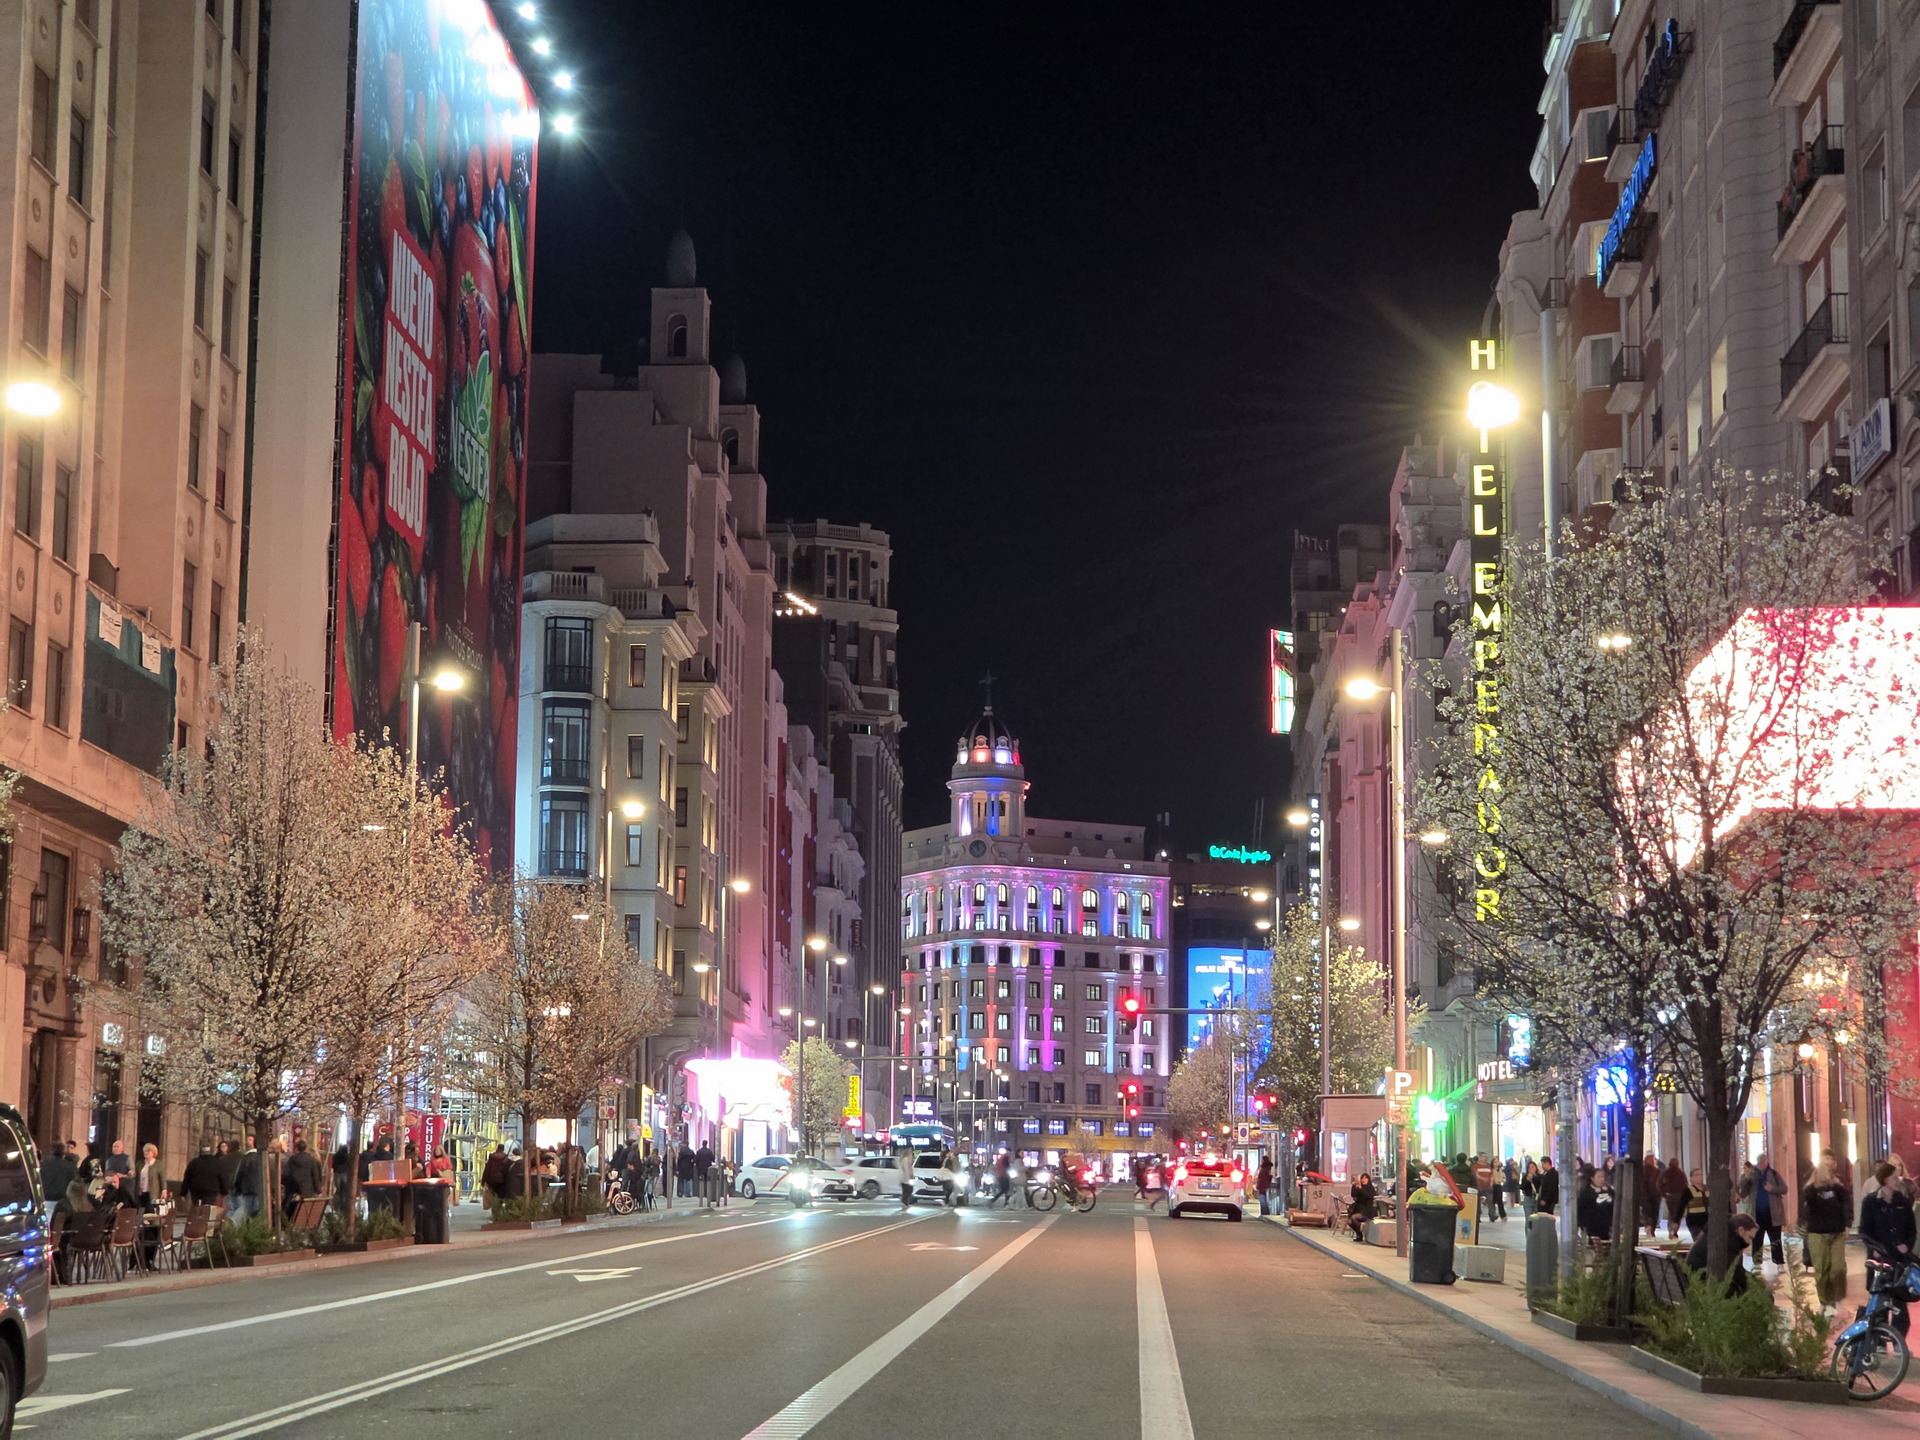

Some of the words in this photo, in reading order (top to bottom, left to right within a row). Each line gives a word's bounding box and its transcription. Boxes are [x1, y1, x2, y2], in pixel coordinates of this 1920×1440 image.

[391, 229, 435, 359] NUEVO
[385, 321, 433, 456] NESTEA
[1469, 339, 1498, 535] HTEL
[387, 422, 425, 538] ROJO
[450, 399, 490, 504] NESTEA
[1310, 798, 1320, 852] ROOM
[1395, 1071, 1412, 1095] P
[1477, 1060, 1515, 1081] HOTEL
[425, 1117, 434, 1166] CHURR
